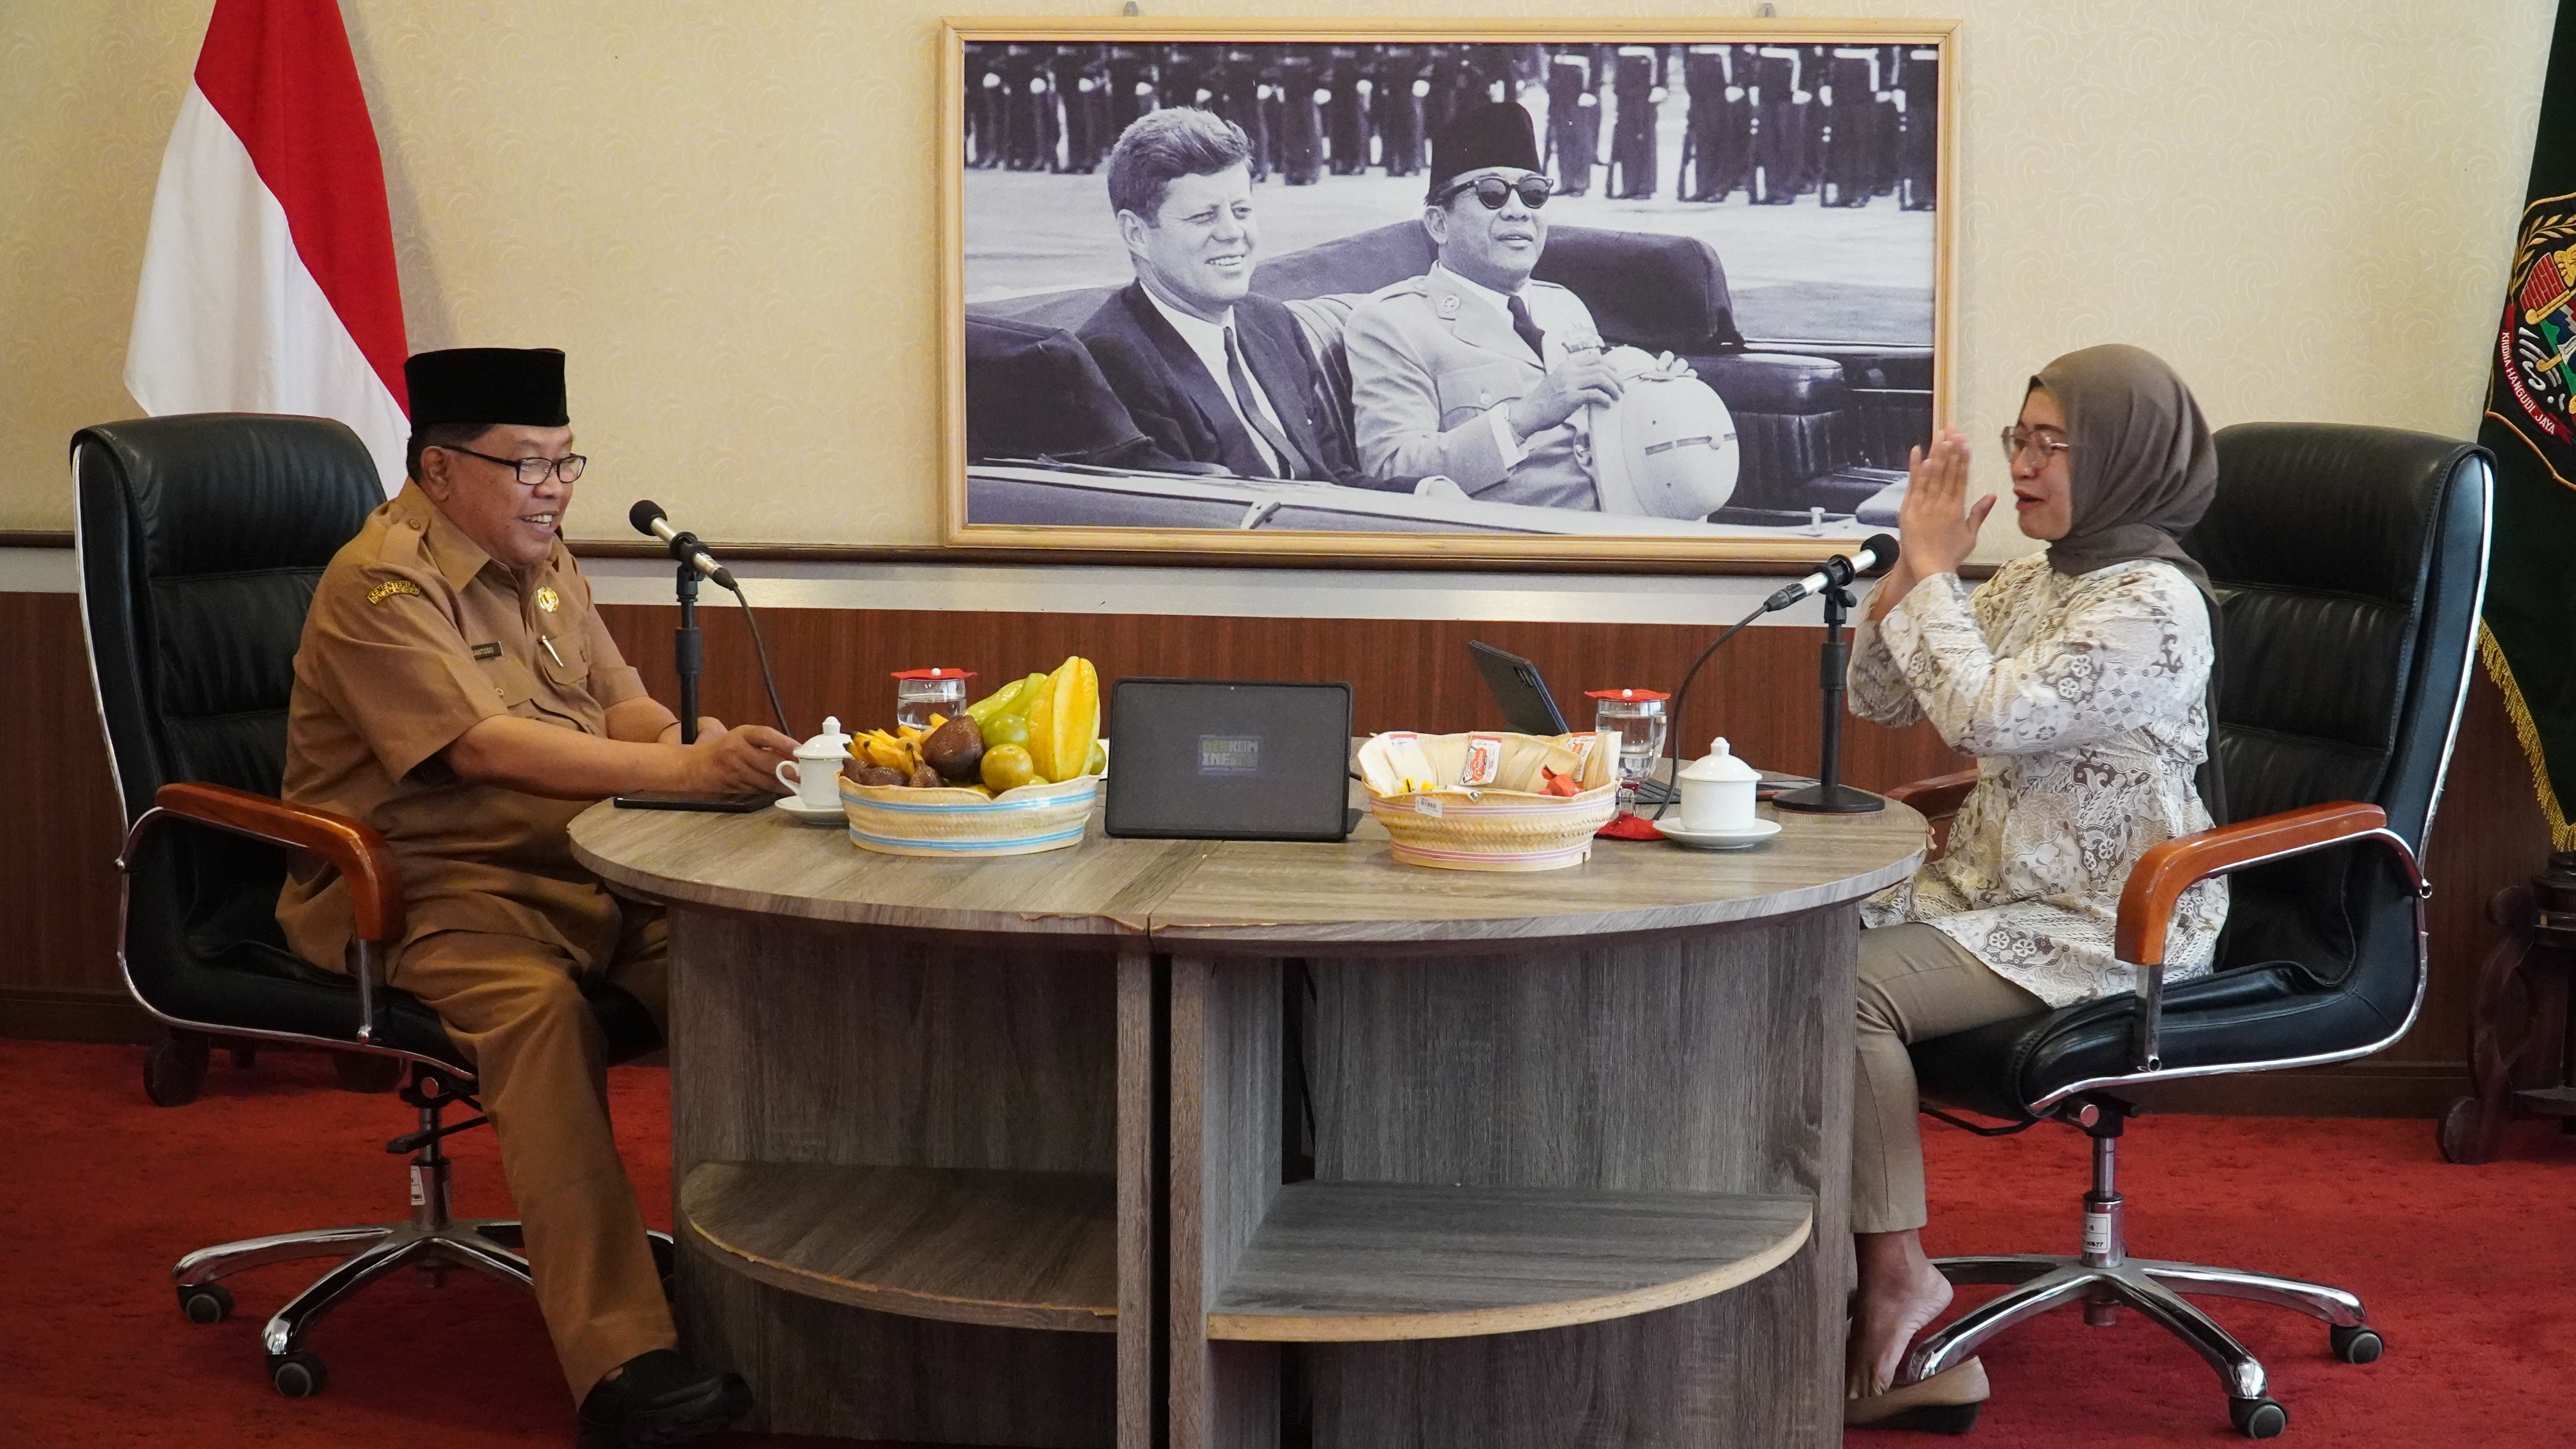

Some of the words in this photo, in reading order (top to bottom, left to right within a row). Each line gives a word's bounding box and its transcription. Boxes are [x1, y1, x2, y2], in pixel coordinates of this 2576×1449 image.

[2502, 332, 2512, 367] KRIDHA
[2506, 367, 2536, 413] HANGUDI
[2535, 413, 2555, 434] JAYA
[472, 647, 494, 656] SANTOSO
